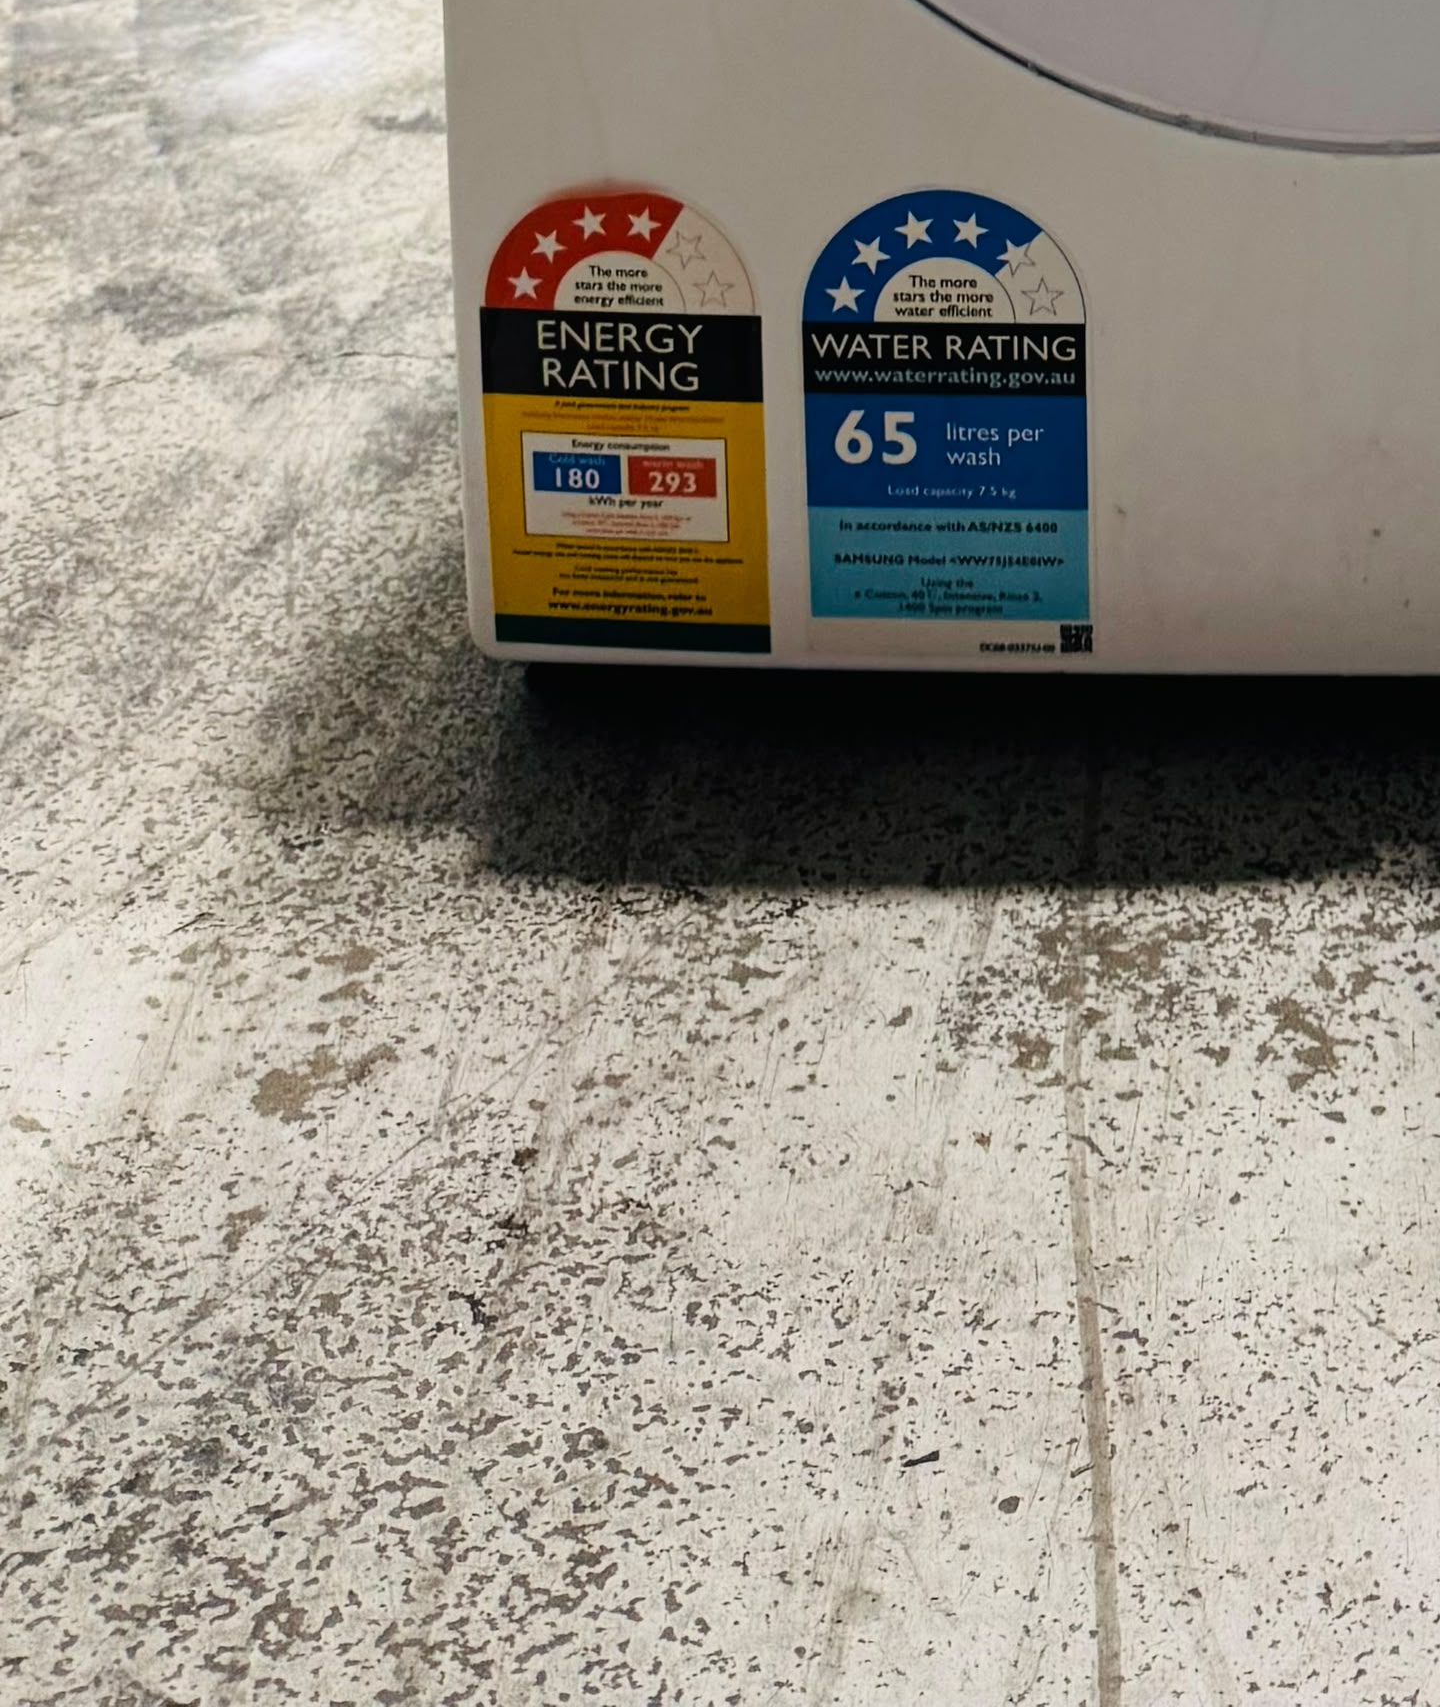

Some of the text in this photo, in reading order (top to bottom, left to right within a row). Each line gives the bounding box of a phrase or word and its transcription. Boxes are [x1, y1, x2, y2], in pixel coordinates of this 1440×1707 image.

[589, 265, 648, 278] The more
[575, 281, 663, 292] stars the more
[909, 275, 977, 288] The more
[574, 295, 664, 307] energy efficient
[893, 290, 994, 304] stars the more
[895, 304, 993, 318] water efficient
[536, 319, 703, 355] ENERGY
[811, 333, 1076, 361] WATER RATING
[542, 357, 699, 391] RATING
[814, 367, 1076, 388] www.waterrating.gov.au
[834, 409, 1044, 465] 65 litres per
[572, 439, 670, 453] Energy consumption
[946, 447, 1000, 466] wash
[555, 466, 600, 489] 180
[650, 471, 697, 493] 293
[888, 485, 919, 496] Load
[923, 486, 973, 499] capacity
[1002, 486, 1017, 499] kg
[589, 496, 663, 511] kWh per year
[839, 519, 1058, 533] In accordance with AS/NZS 6400
[834, 553, 904, 566] SAMSUNG
[908, 554, 946, 565] Model
[548, 601, 712, 617] www.energyrating.gov.au
